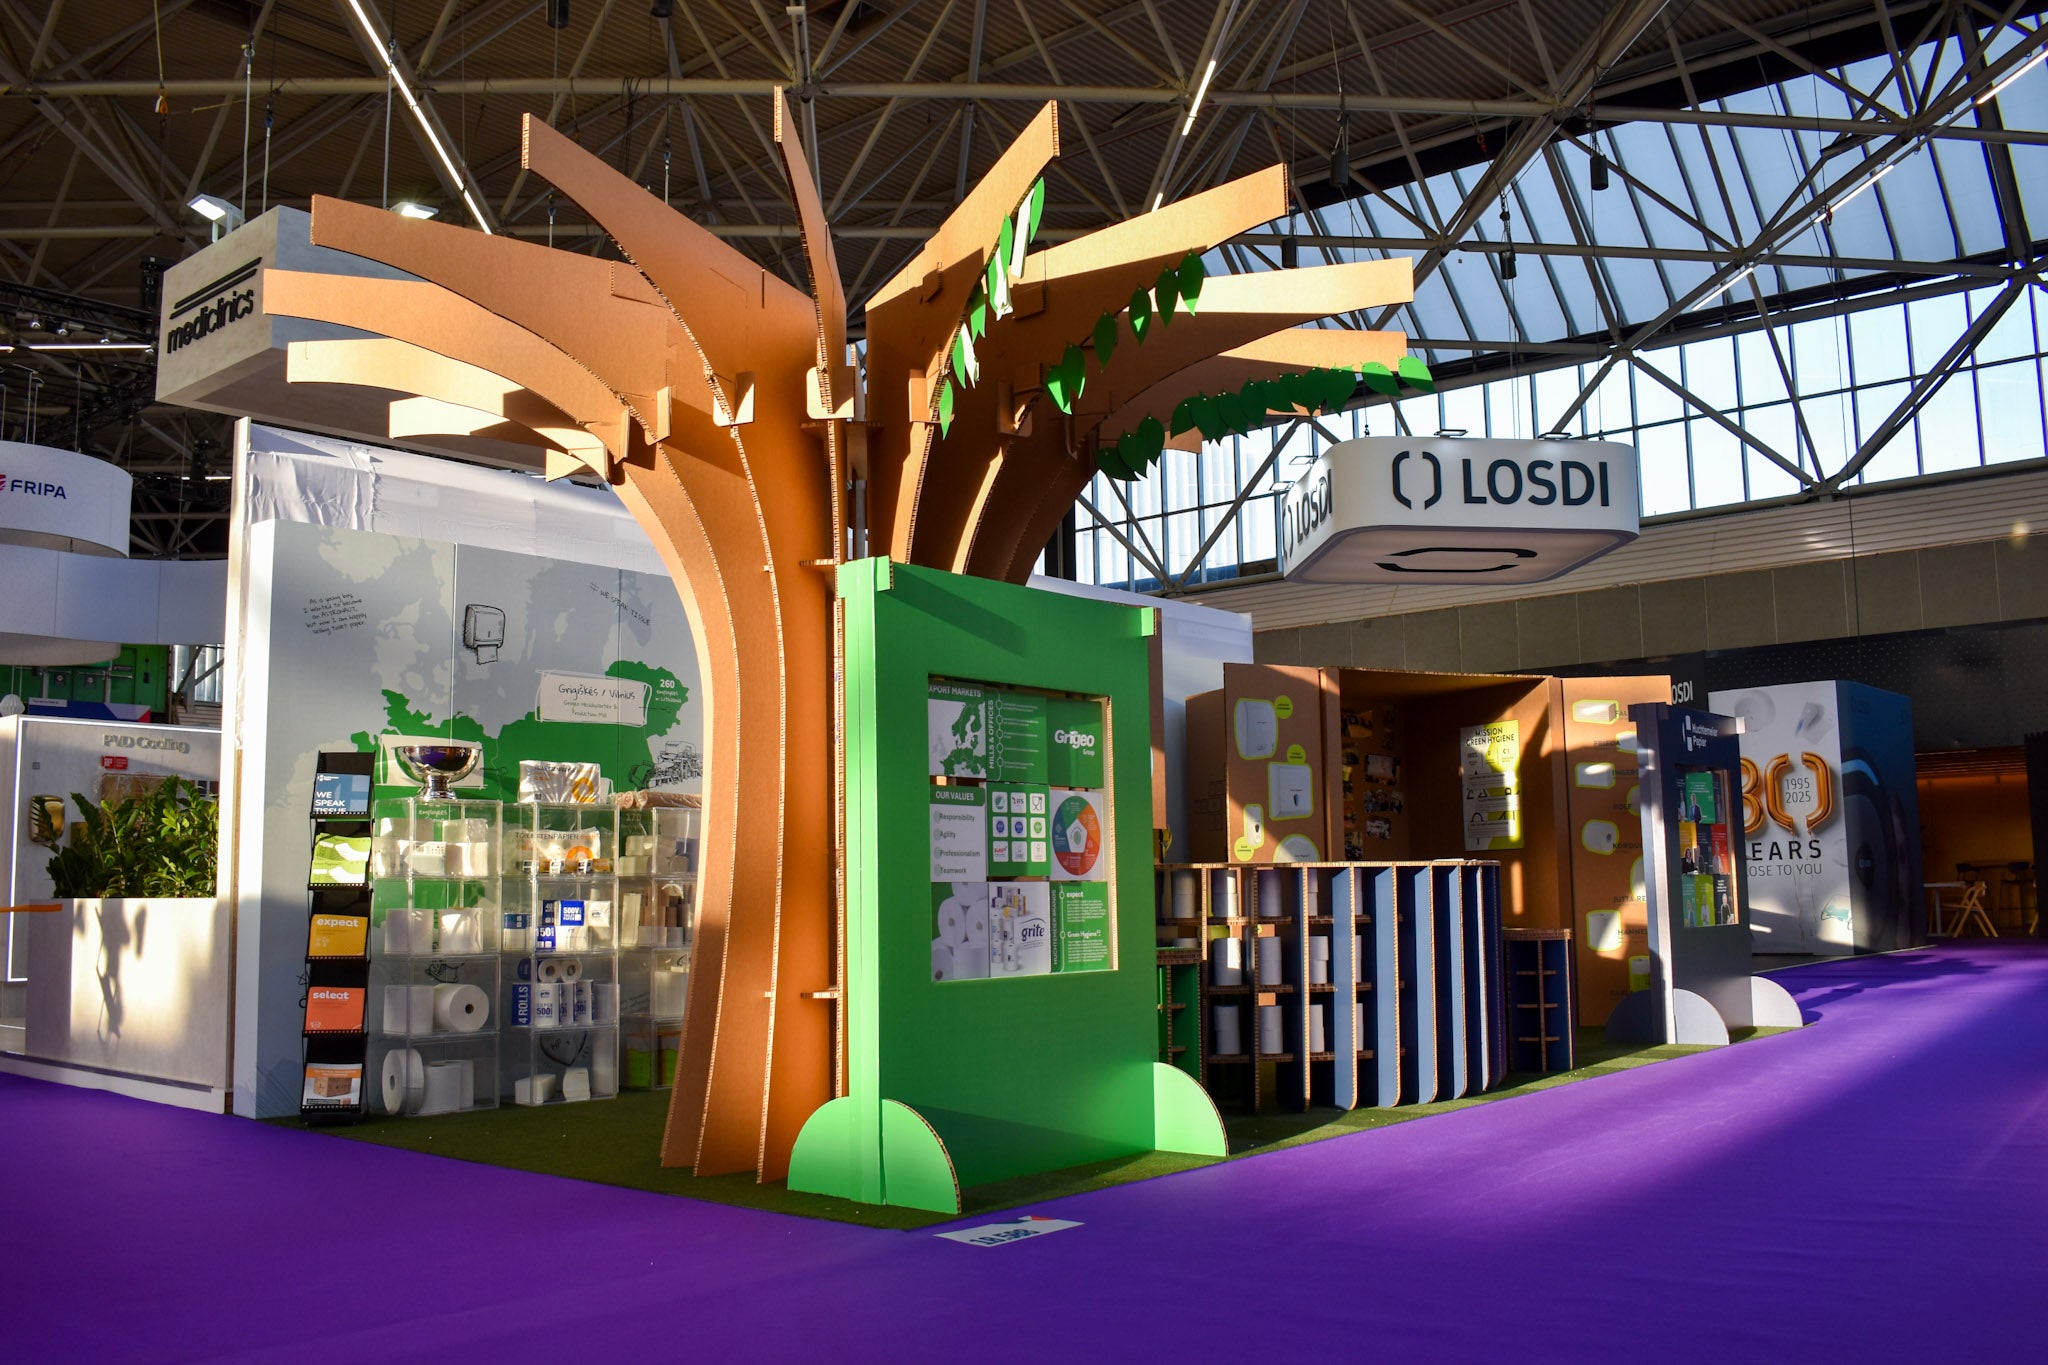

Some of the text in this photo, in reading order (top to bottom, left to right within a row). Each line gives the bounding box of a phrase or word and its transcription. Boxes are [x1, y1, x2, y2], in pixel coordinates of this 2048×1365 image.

[167, 289, 254, 354] mediclinics
[10, 479, 67, 500] FRIPA
[1462, 458, 1610, 507] LOSDI
[1296, 468, 1333, 544] LOSDI
[660, 678, 675, 689] 260
[609, 689, 636, 700] Vilnius
[928, 684, 982, 698] XPORT MARKETS
[1671, 680, 1693, 705] OSDI
[1054, 729, 1095, 749] Grigeo
[1475, 727, 1503, 737] MISSION
[104, 734, 135, 748] PVD
[1466, 734, 1515, 747] GREEN HYGIENE
[1785, 777, 1810, 791] 1995
[316, 791, 332, 799] WE
[935, 790, 975, 801] OUR VALUES
[1785, 790, 1811, 804] 2025
[315, 799, 346, 807] SPEAK
[939, 810, 975, 822] Responsibility
[939, 830, 956, 839] Agility
[939, 848, 981, 858] Professionalism
[1613, 842, 1643, 850] KORDU
[1751, 839, 1822, 861] EARS
[939, 865, 967, 874] Teamwork
[1748, 863, 1822, 877] OSE TO YOU
[1613, 895, 1646, 903] JUTTA-RE
[1021, 924, 1045, 942] grite
[517, 986, 529, 1016] ROLLS
